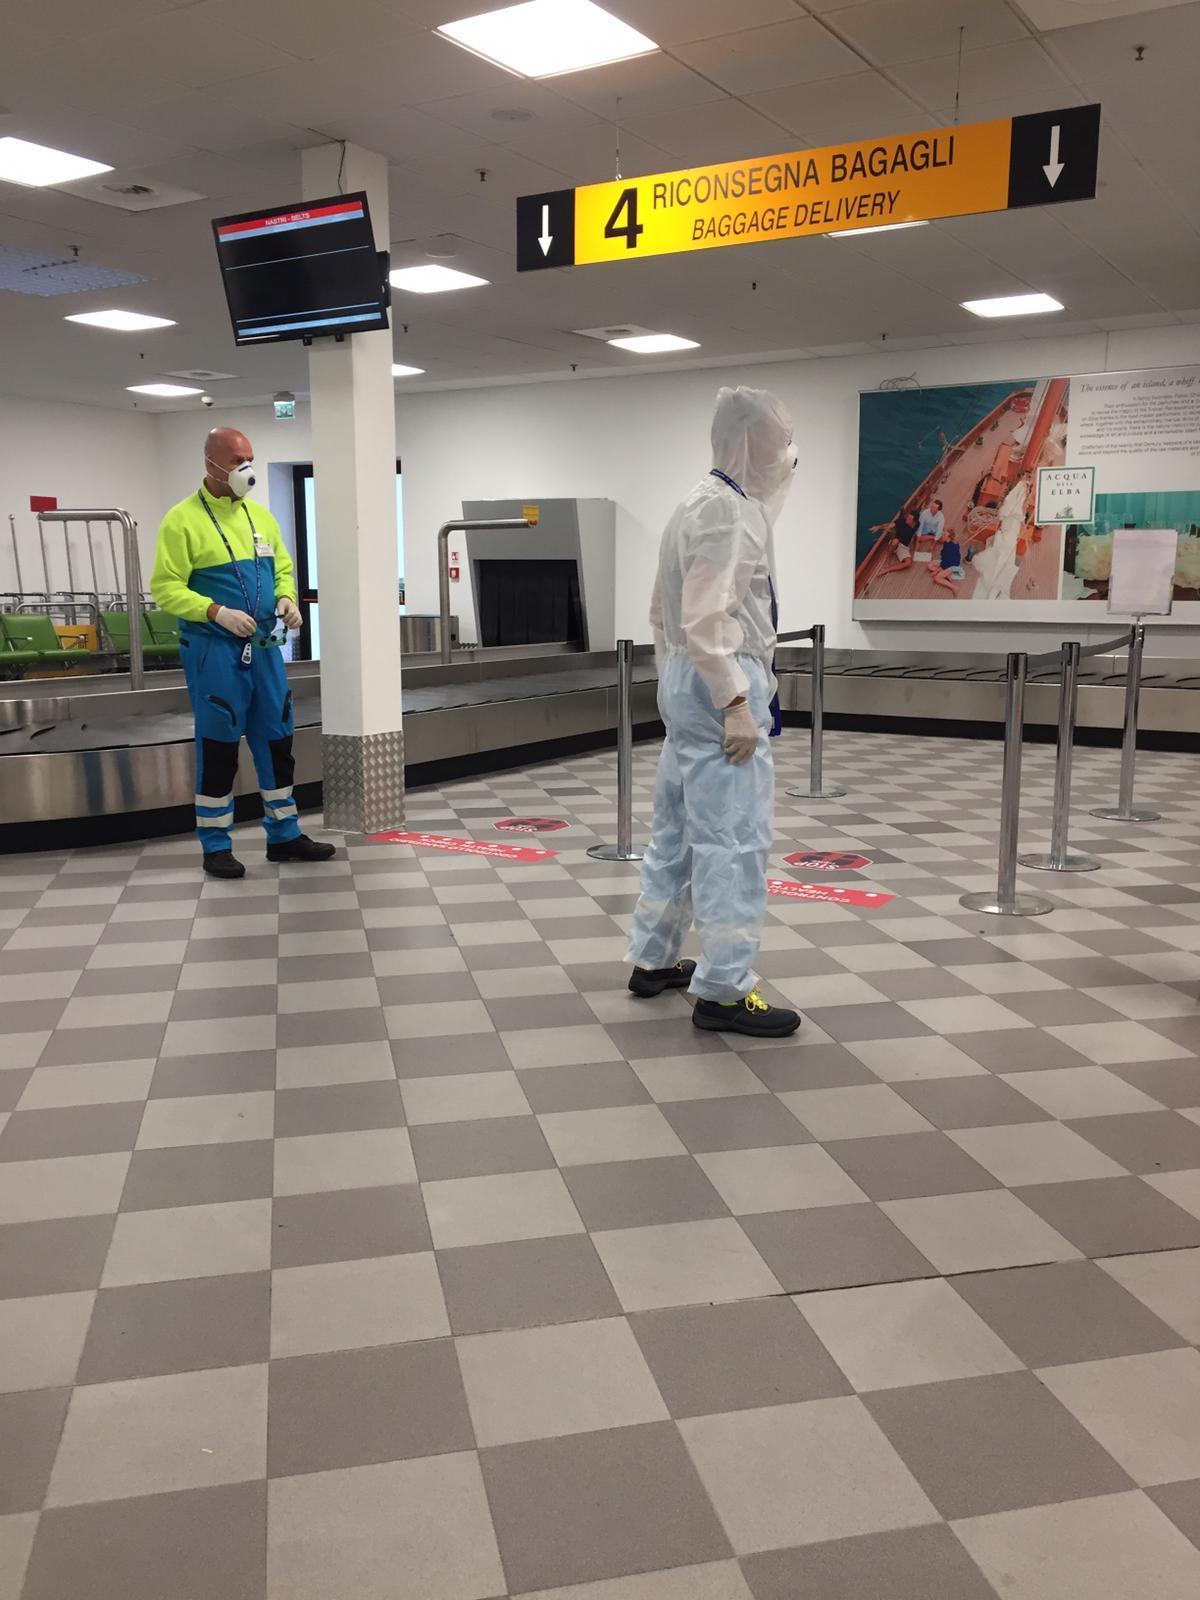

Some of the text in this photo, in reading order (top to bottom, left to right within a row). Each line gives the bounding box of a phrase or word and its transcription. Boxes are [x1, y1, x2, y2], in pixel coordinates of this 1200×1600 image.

[653, 136, 955, 210] RICONSEGNA BAGAGLI
[265, 217, 287, 226] NASTRI
[291, 213, 310, 222] BELTS
[604, 187, 643, 250] 4
[692, 190, 901, 241] BAGGAGE DELIVERY
[1081, 384, 1093, 392] The
[1120, 382, 1129, 392] of
[1046, 473, 1087, 481] ACQUA
[1051, 488, 1081, 496] ELBA
[794, 861, 840, 870] STOP
[767, 888, 851, 903] CONTROLL
[768, 884, 828, 895] HEALTH
